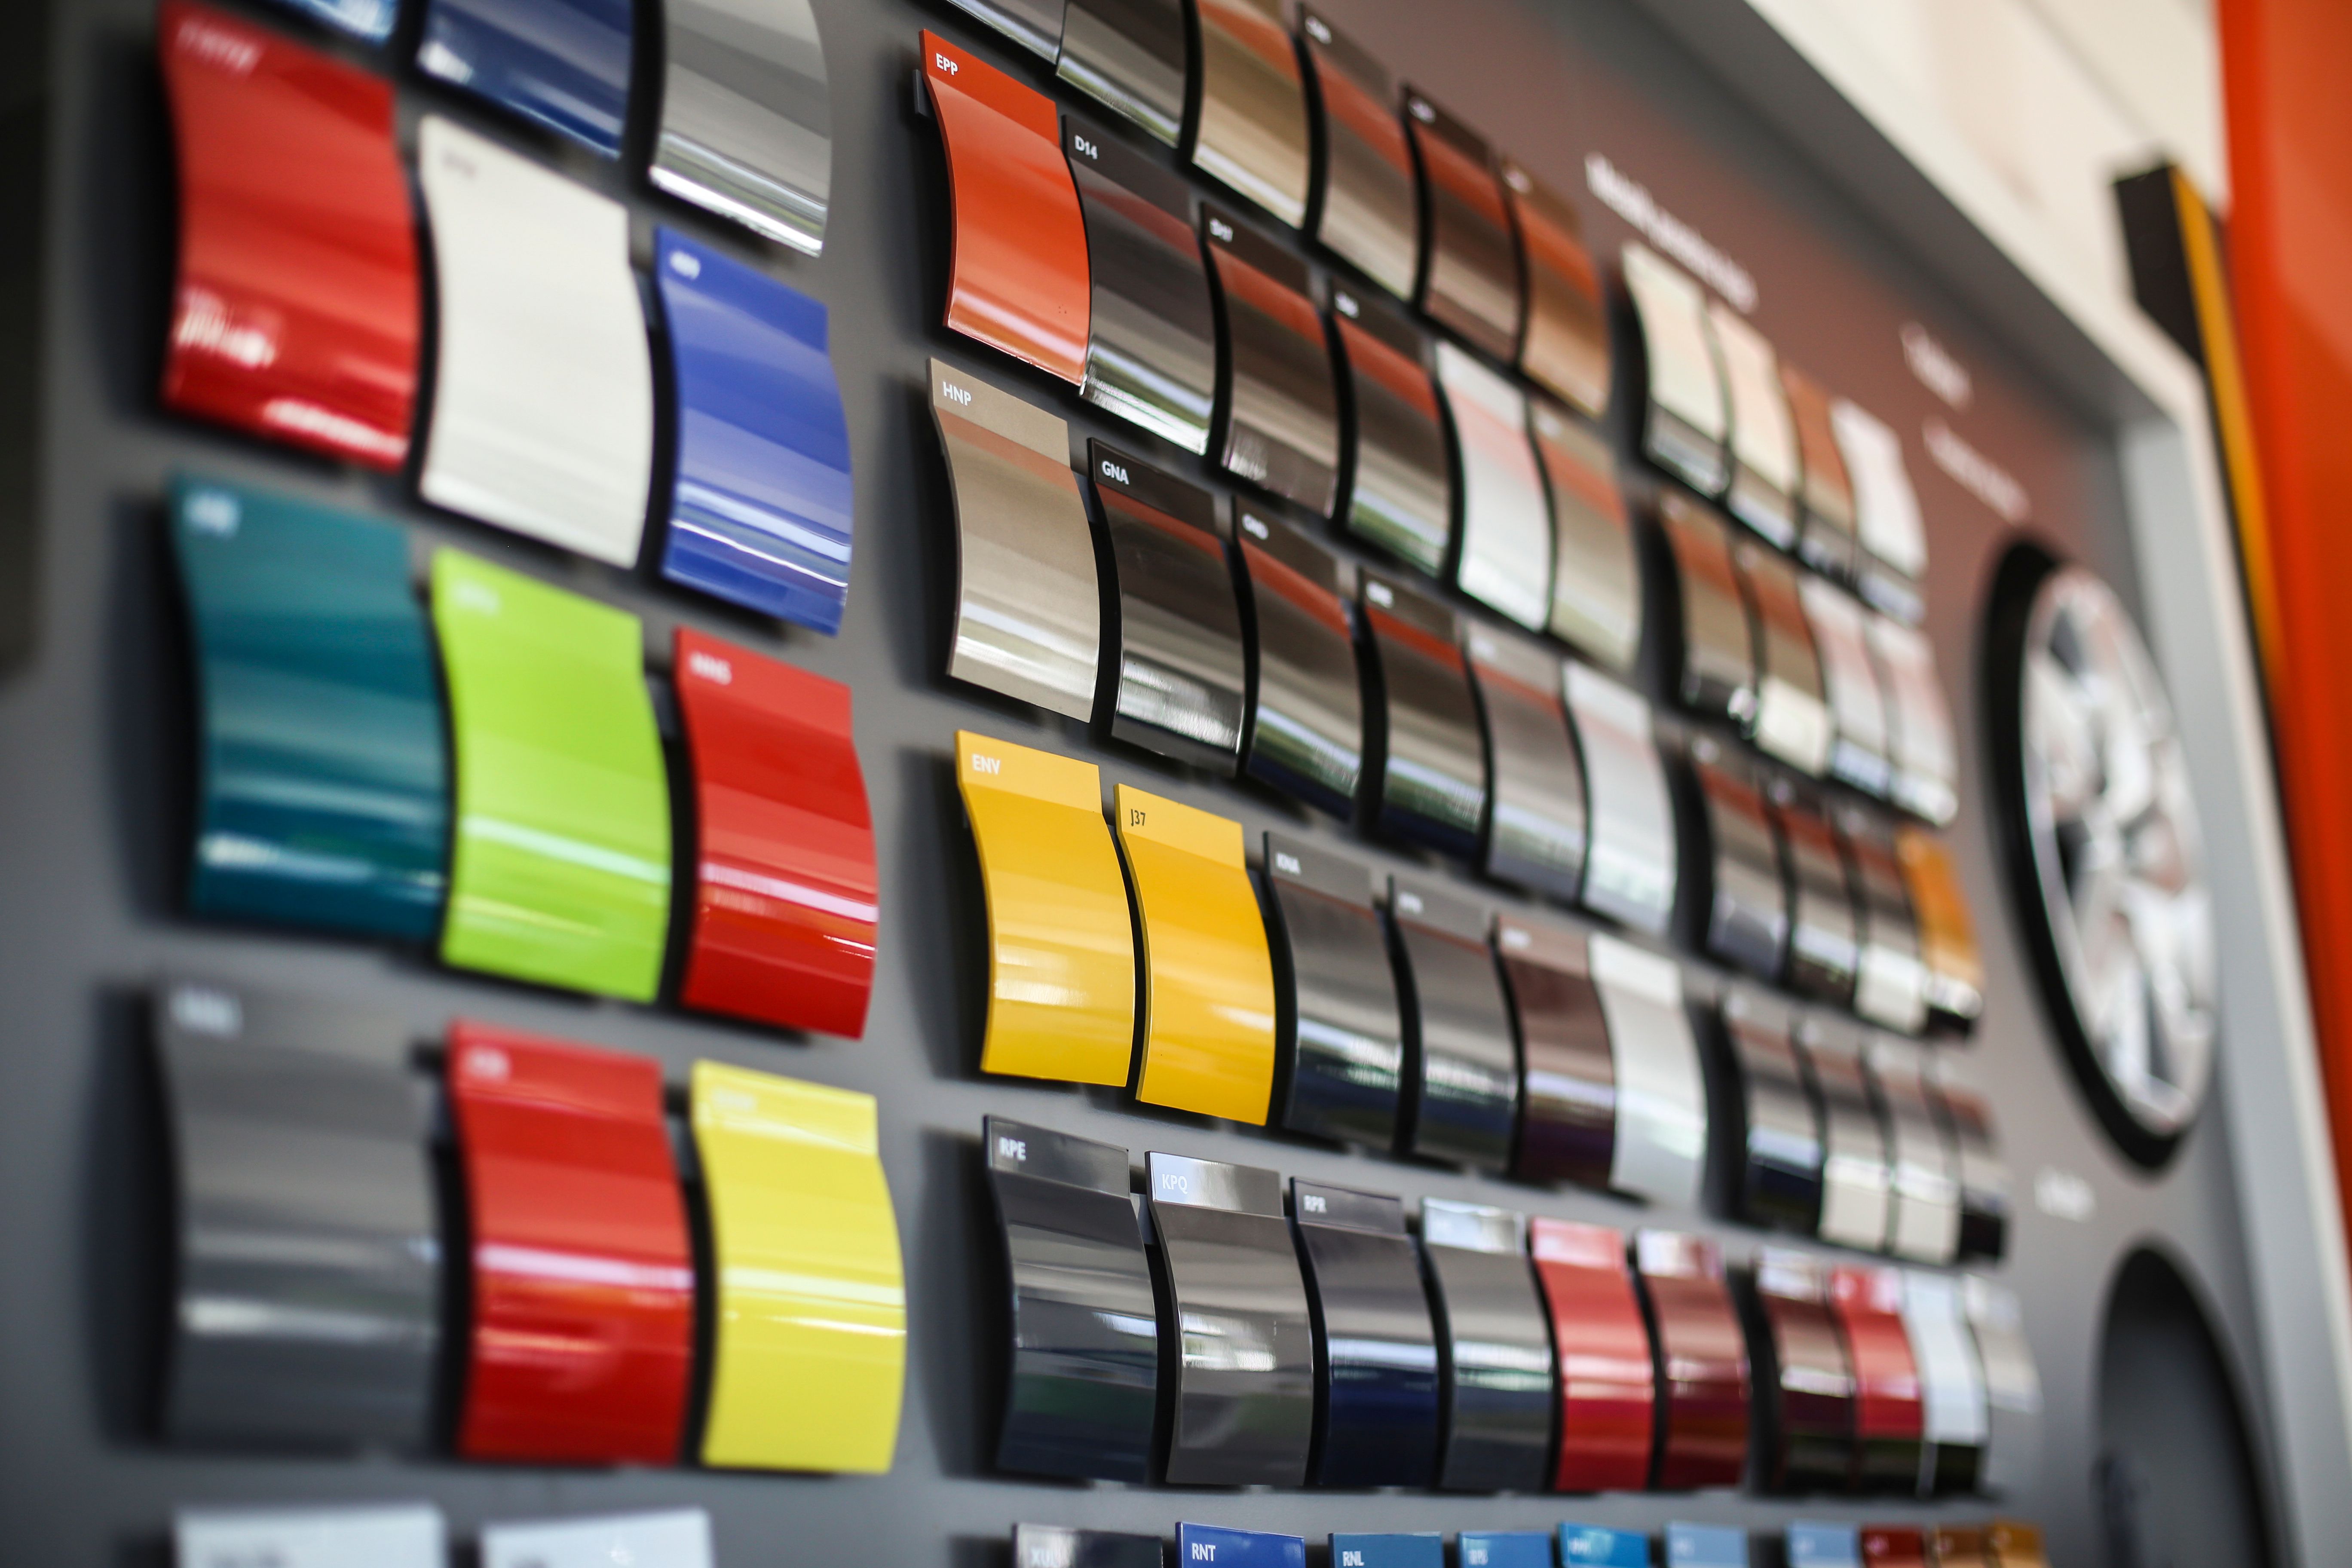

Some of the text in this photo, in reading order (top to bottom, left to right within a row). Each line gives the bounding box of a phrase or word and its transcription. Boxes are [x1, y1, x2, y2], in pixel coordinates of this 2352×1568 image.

[936, 52, 959, 76] EPP
[1074, 135, 1098, 159] D14
[943, 381, 971, 406] HNP
[1101, 460, 1129, 485] GNA
[972, 754, 1001, 775] ENV
[1130, 808, 1146, 827] J37
[999, 1137, 1026, 1161] RPE
[1162, 1174, 1188, 1194] KPQ
[1192, 1543, 1216, 1562] RNT
[1343, 1550, 1364, 1567] RNL
